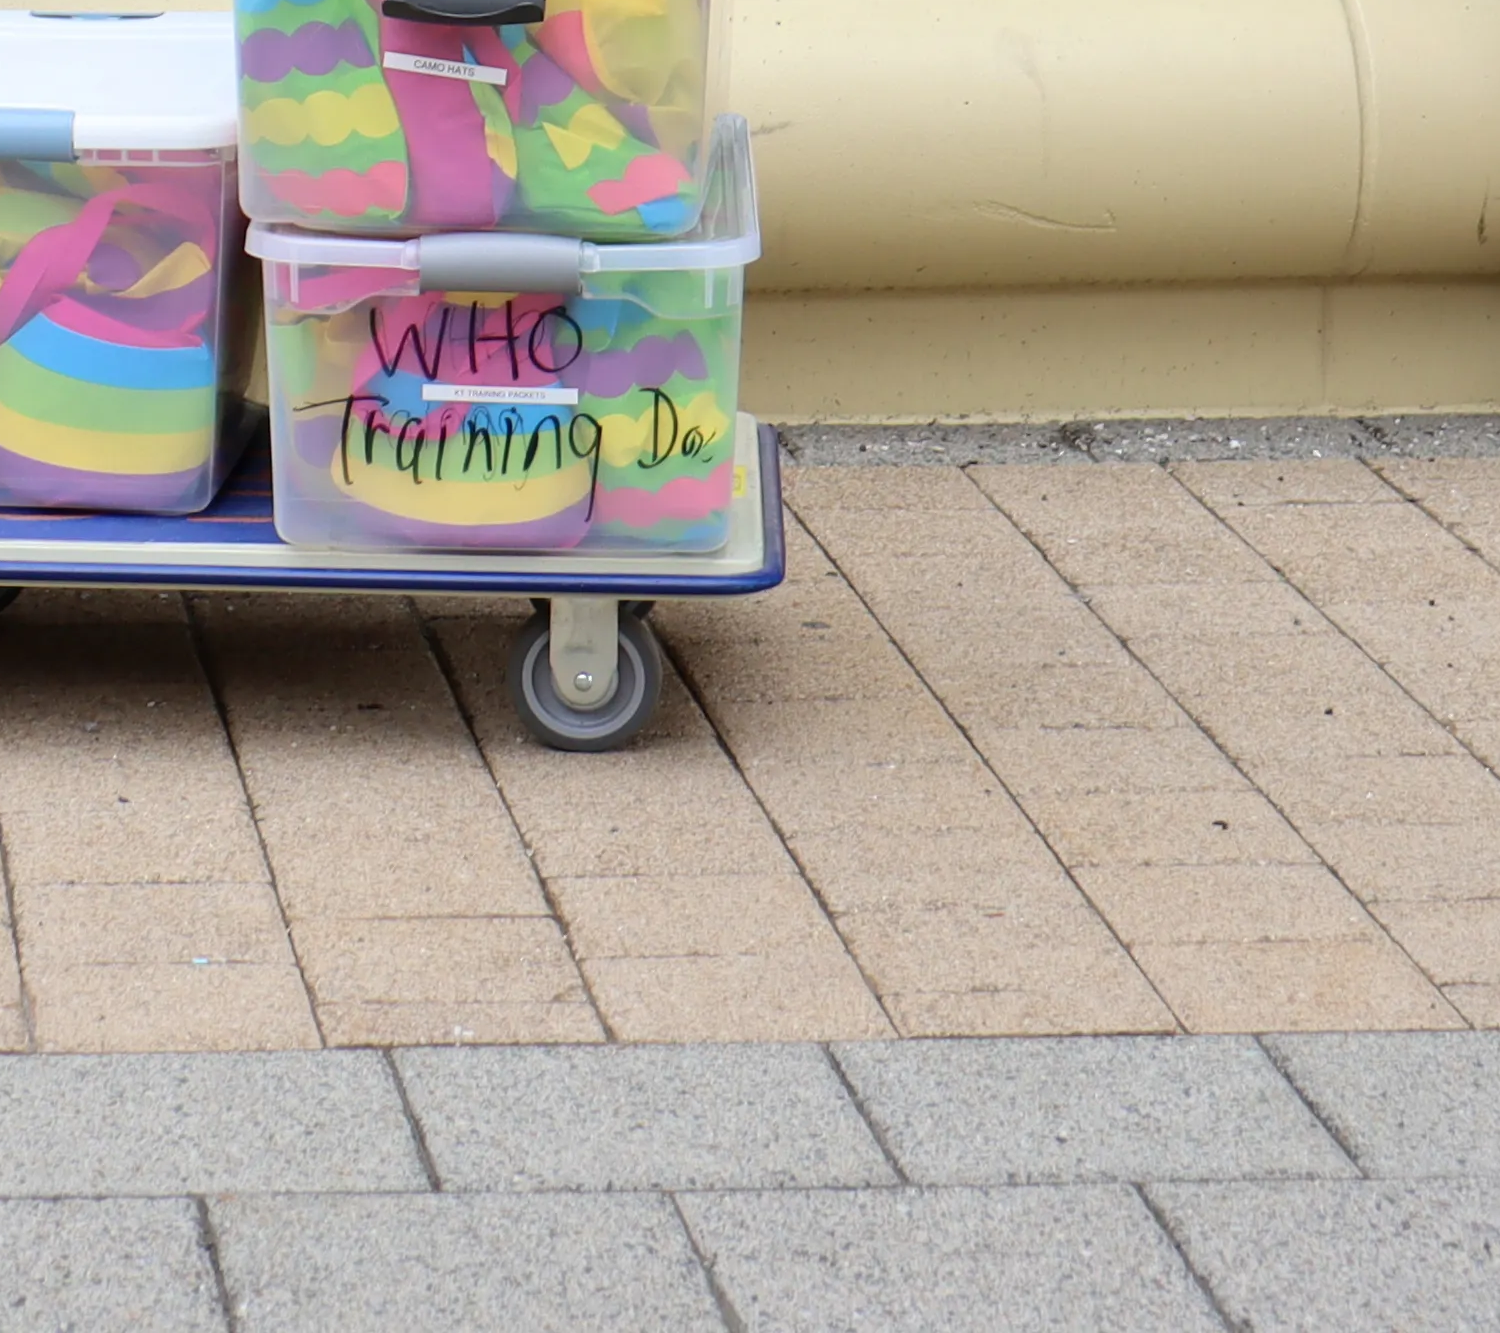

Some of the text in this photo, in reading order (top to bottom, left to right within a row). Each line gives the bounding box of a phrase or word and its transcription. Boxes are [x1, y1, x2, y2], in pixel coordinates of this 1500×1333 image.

[413, 59, 476, 78] CAMO HATS
[368, 299, 584, 381] WHO
[467, 390, 507, 399] TRAINING
[508, 391, 547, 400] PACKETS
[292, 393, 603, 523] Training
